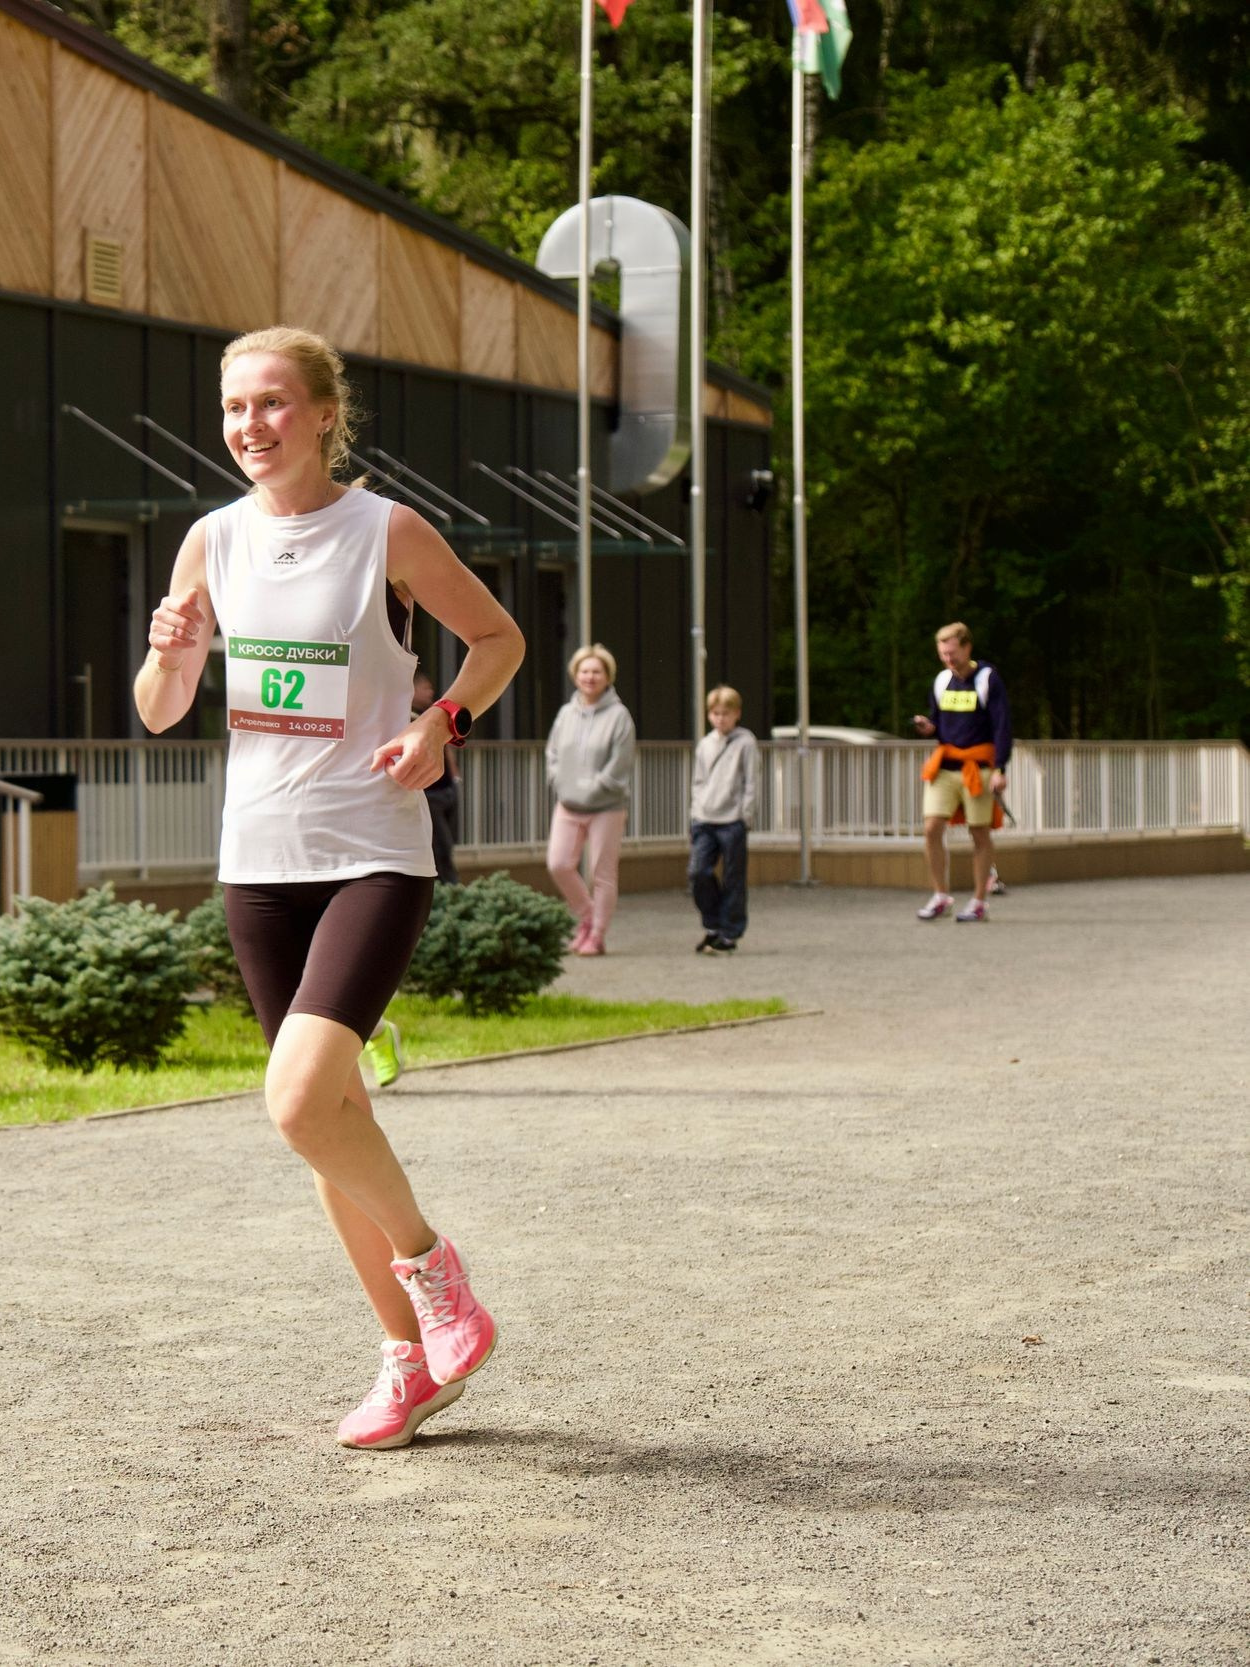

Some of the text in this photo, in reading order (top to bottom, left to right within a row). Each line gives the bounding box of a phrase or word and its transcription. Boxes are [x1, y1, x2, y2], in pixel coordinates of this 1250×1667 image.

[238, 643, 336, 660] КРОСС ДУБКИ
[261, 668, 306, 709] 62
[239, 717, 332, 733] Апрелевка 14.09.25
